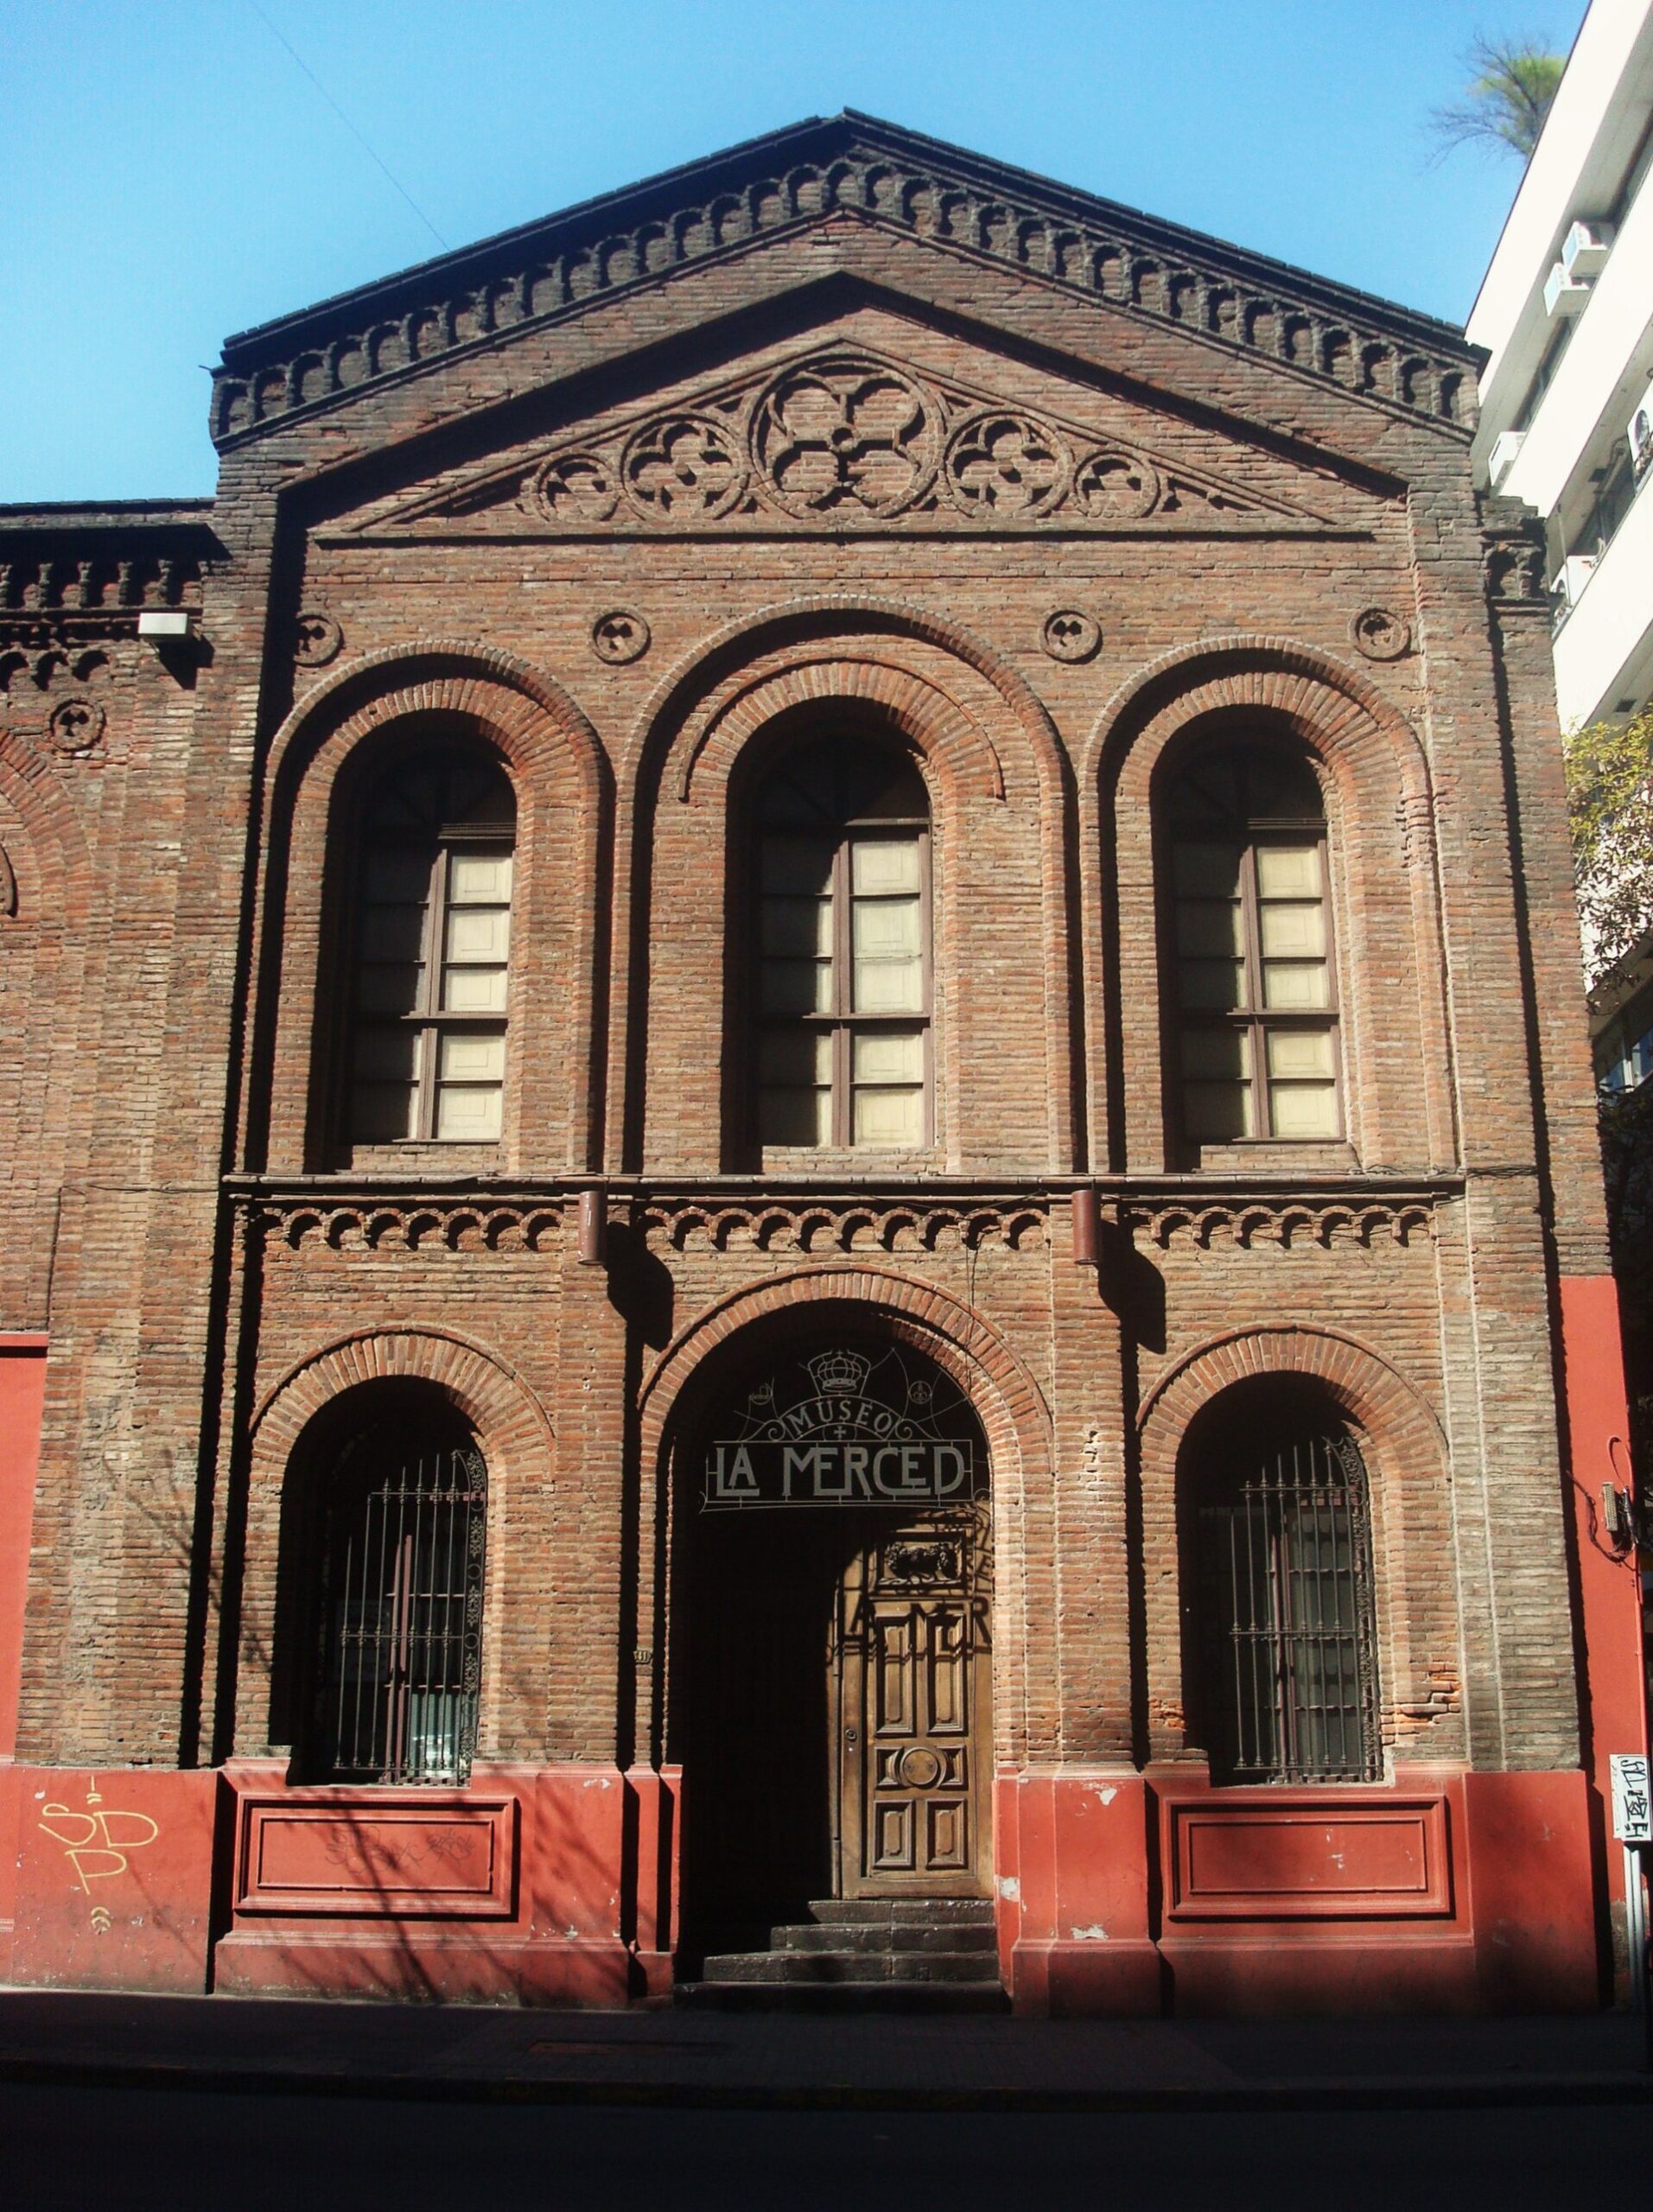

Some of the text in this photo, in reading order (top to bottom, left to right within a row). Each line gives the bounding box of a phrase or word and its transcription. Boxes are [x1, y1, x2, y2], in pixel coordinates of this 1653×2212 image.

[785, 1400, 893, 1437] MUSEO
[715, 1446, 965, 1497] LA MERCED
